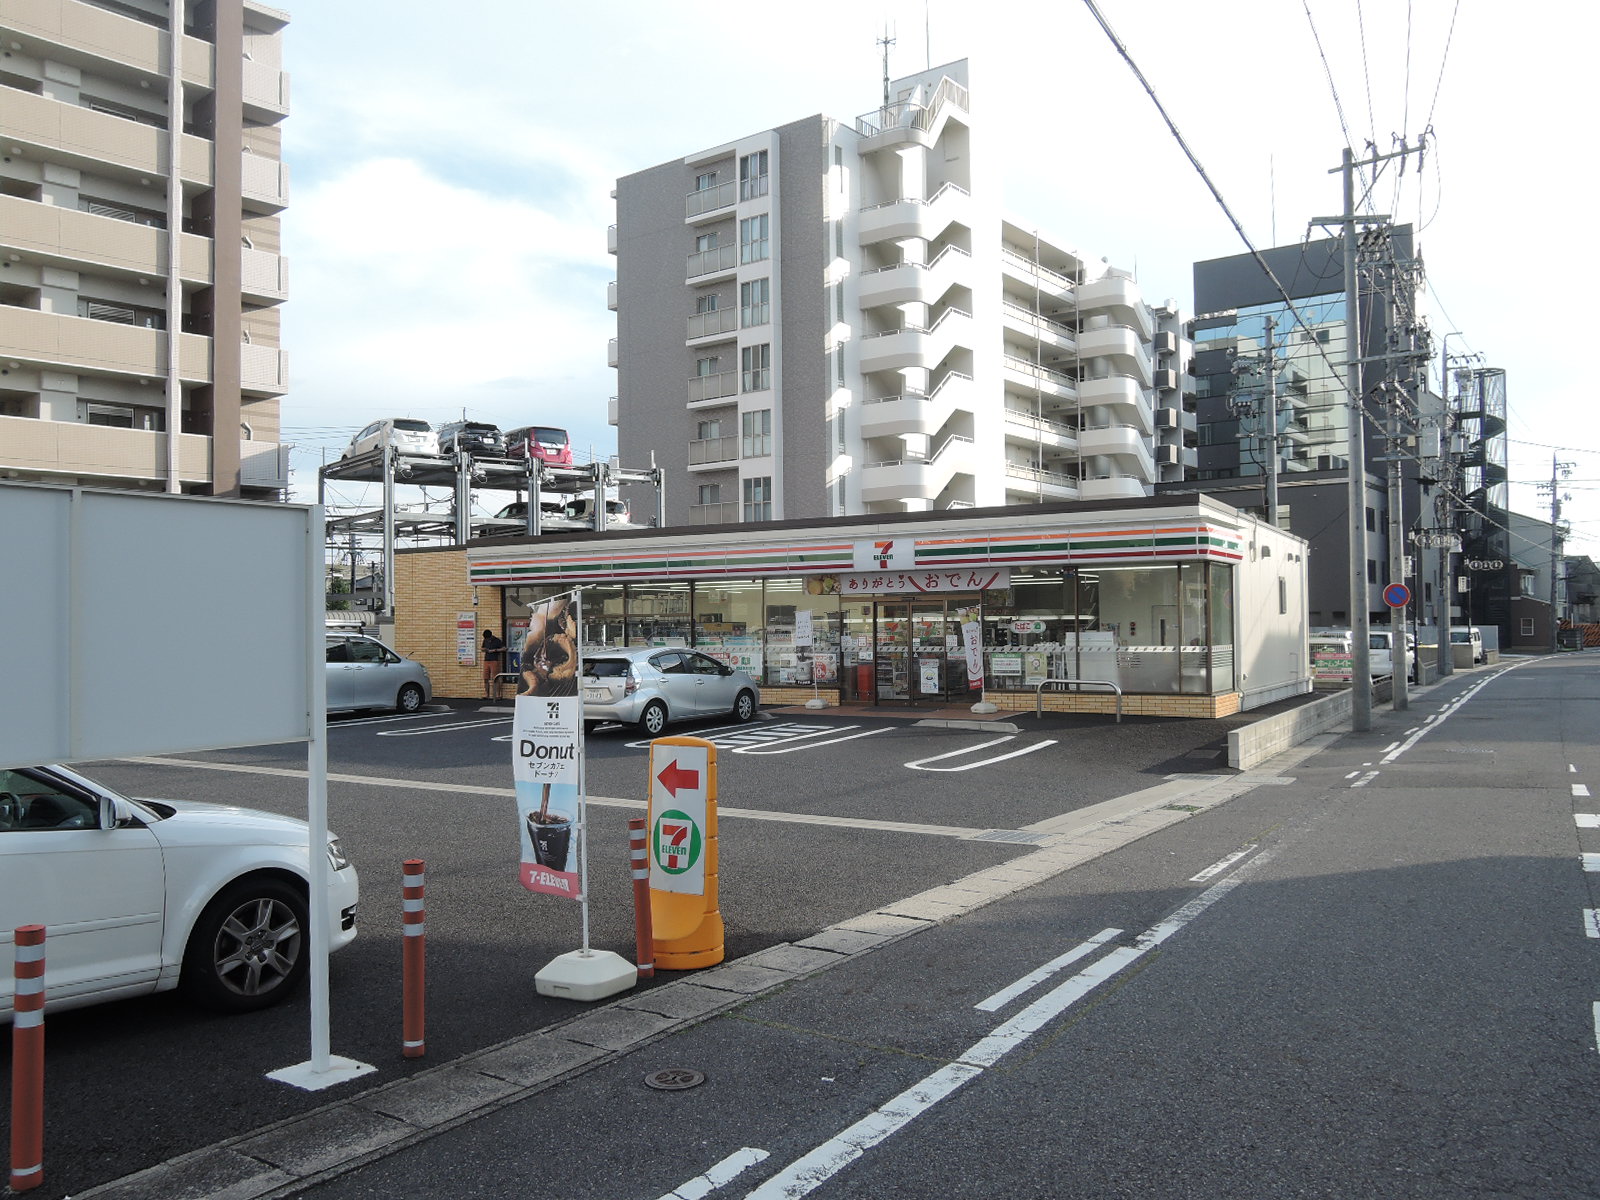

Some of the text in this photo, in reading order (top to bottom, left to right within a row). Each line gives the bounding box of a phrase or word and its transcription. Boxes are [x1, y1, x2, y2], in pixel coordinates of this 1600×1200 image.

[874, 541, 894, 569] 7
[849, 571, 983, 590] ありがとう おでん
[1014, 622, 1031, 630] たばこ
[970, 635, 979, 670] おでん
[520, 739, 575, 760] Donut
[528, 760, 566, 770] セブンカフェ
[663, 825, 688, 868] 7
